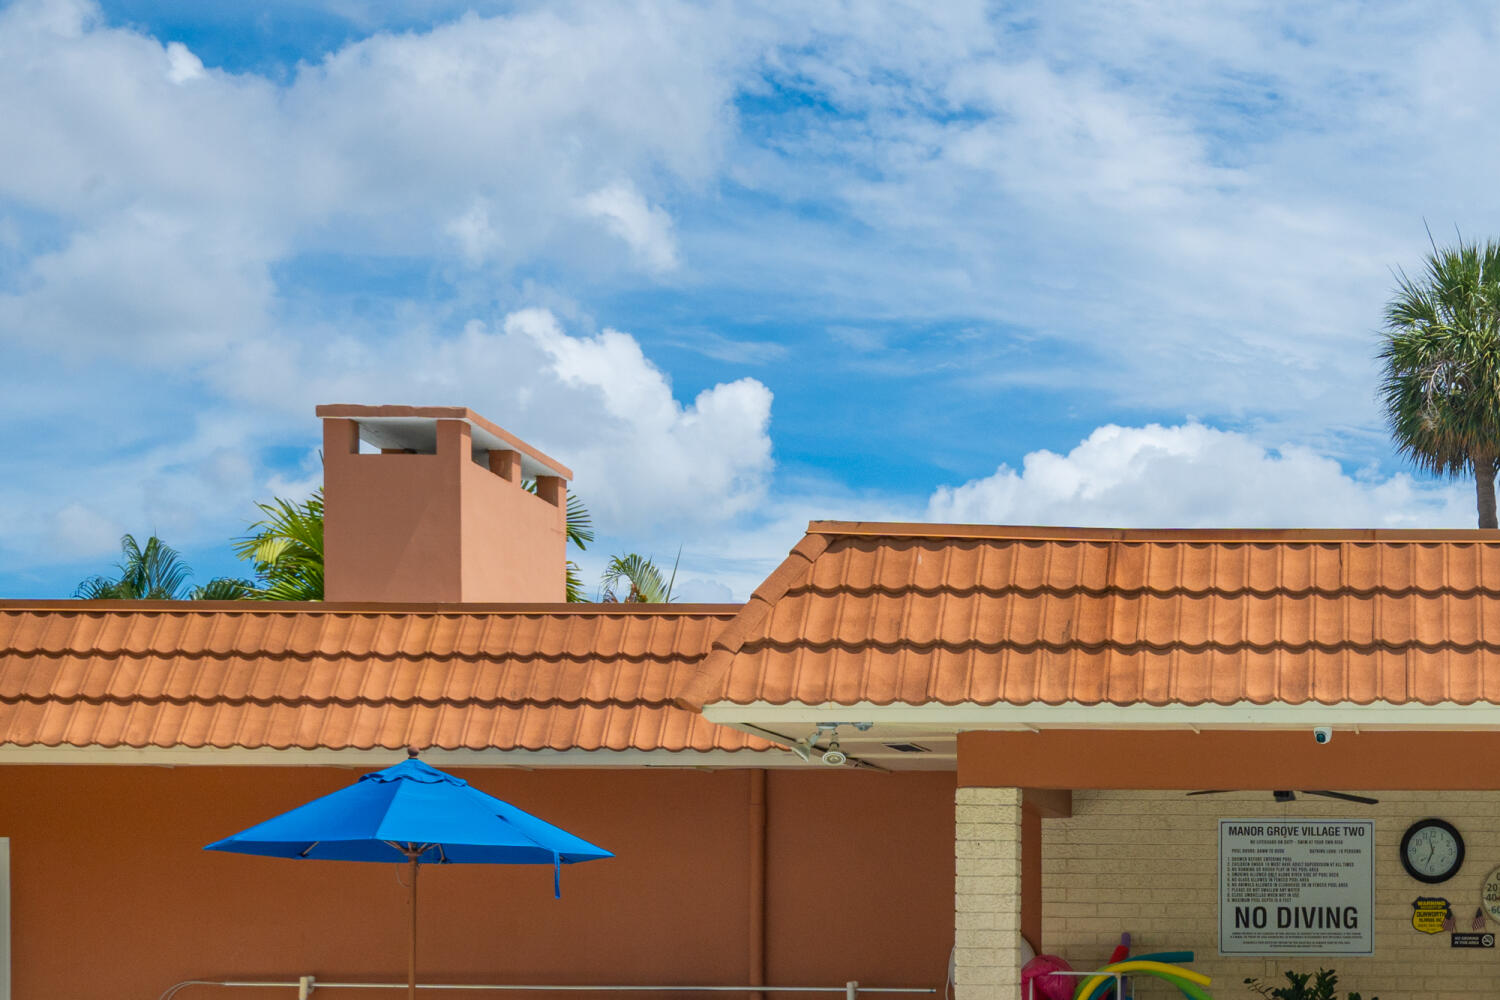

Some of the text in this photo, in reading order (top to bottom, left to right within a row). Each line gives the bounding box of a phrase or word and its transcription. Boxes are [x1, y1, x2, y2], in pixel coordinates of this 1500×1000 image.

[1228, 826, 1365, 837] MANOR GROVE VILLAGE TWO
[1416, 838, 1422, 846] 10
[1235, 906, 1358, 929] NO DIVING
